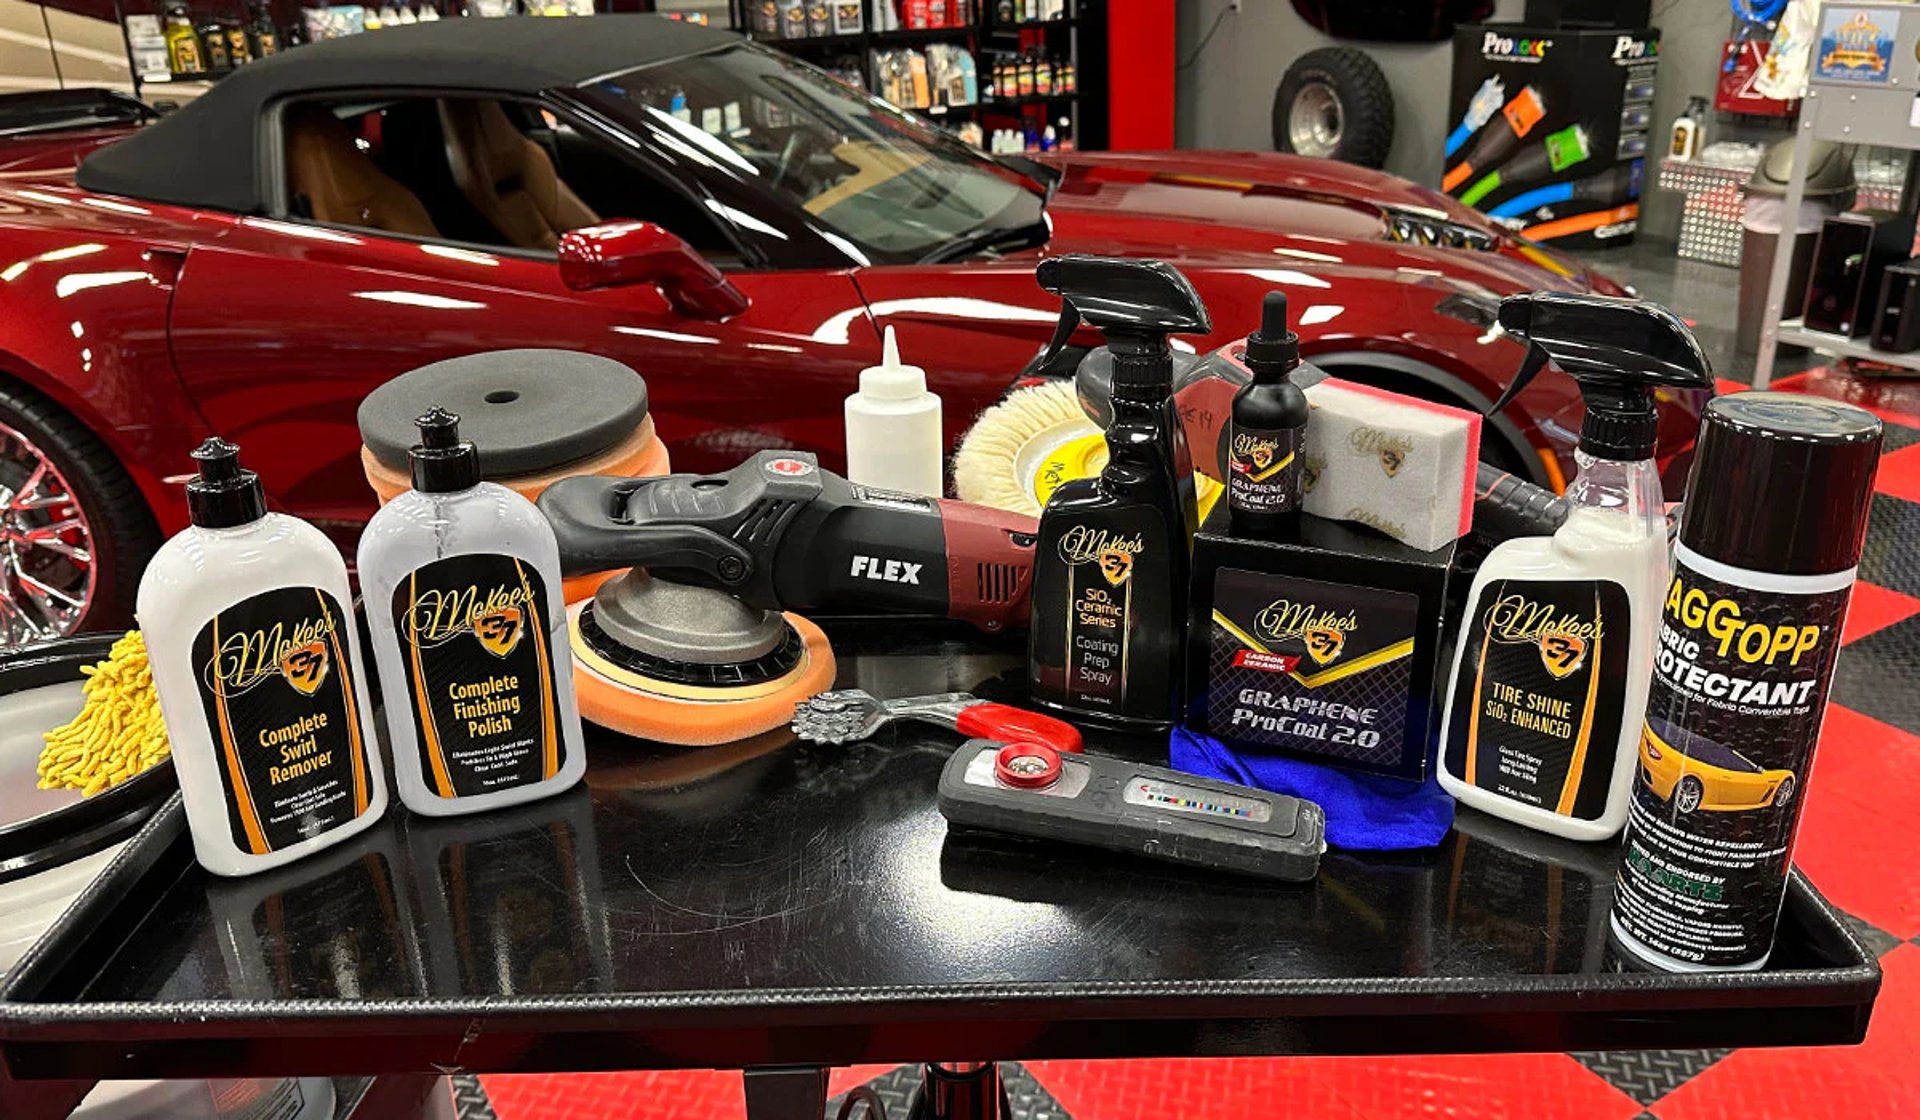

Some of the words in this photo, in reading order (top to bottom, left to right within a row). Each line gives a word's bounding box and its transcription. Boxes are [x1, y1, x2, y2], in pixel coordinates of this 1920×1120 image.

[1057, 525, 1144, 565] McKee's
[850, 555, 924, 585] FLEX
[1105, 554, 1128, 577] 37
[401, 573, 535, 648] McKee's
[1075, 599, 1122, 617] Ceramic
[1079, 612, 1116, 629] Series
[1254, 599, 1358, 643] McKee's
[1483, 594, 1605, 644] McKee's
[481, 615, 517, 644] 37
[1311, 631, 1339, 657] 37
[205, 611, 337, 698] McKee's
[1076, 635, 1119, 657] Coating
[1084, 652, 1110, 669] Prep
[1547, 638, 1579, 668] 37
[289, 651, 324, 682] 37
[1080, 666, 1112, 685] Spray
[449, 675, 519, 700] Complete
[1492, 682, 1524, 706] TIRE
[1527, 692, 1572, 720] SHINE
[453, 695, 521, 720] Finishing
[1239, 688, 1378, 726] GRAPHENE
[1707, 698, 1737, 711] Fabric
[1738, 705, 1791, 716] Convertible
[258, 712, 328, 748] Complete
[468, 715, 513, 738] Polish
[1231, 708, 1328, 740] ProCoat
[1331, 725, 1380, 748] 2.0
[1510, 708, 1572, 739] ENHANCED
[280, 734, 317, 764] Swirl
[269, 750, 333, 786] Remover
[1649, 855, 1665, 867] AND
[1665, 863, 1711, 882] ENDORSED
[1711, 876, 1726, 885] BY
